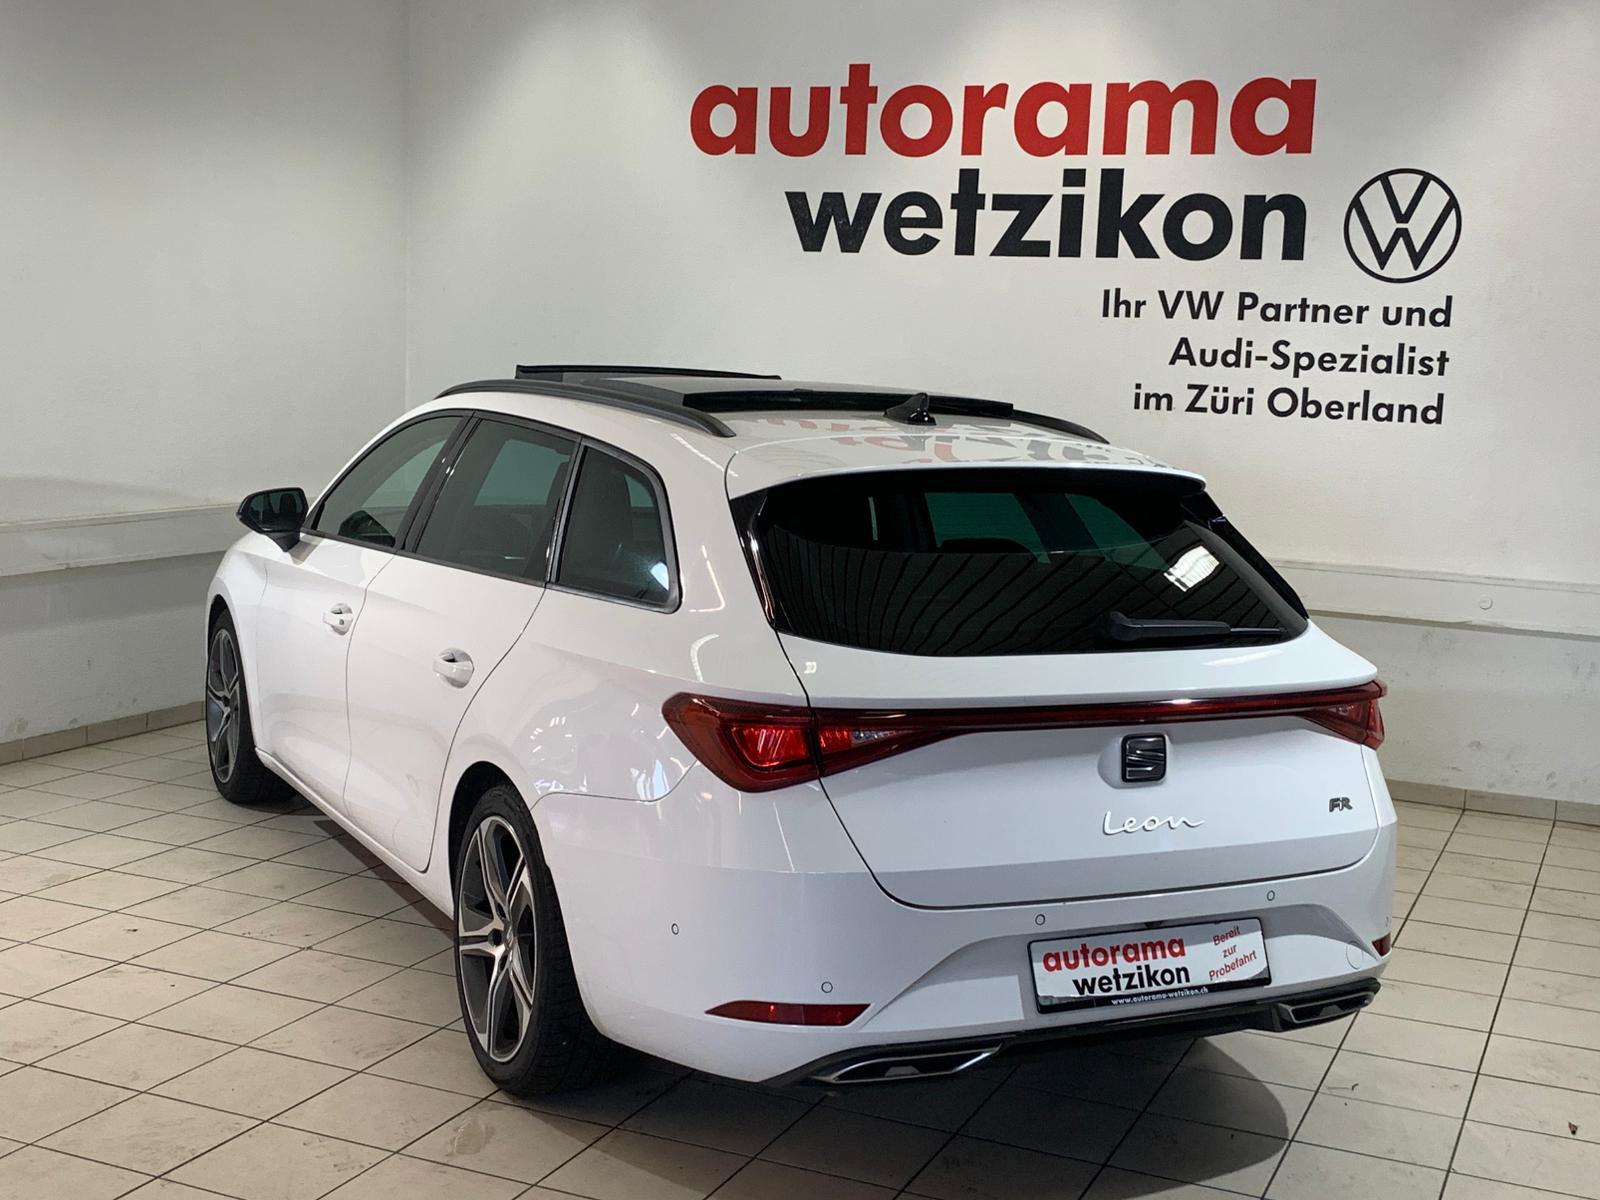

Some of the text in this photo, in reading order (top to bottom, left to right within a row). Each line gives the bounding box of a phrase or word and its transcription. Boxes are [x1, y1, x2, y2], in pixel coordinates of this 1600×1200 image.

[692, 64, 1316, 157] autorama
[785, 168, 1306, 261] wetzikon
[1102, 288, 1453, 327] Ihr VW Partner und
[1168, 337, 1450, 378] Audi-Spezialist
[1133, 383, 1445, 424] im Züri Oberland
[1329, 797, 1352, 812] FR
[1103, 810, 1205, 835] Leon
[1213, 926, 1241, 946] Bereit
[1222, 944, 1238, 958] zur
[1042, 937, 1186, 972] autorama
[1209, 951, 1257, 981] Probefahrt
[1072, 965, 1190, 996] wetzikon
